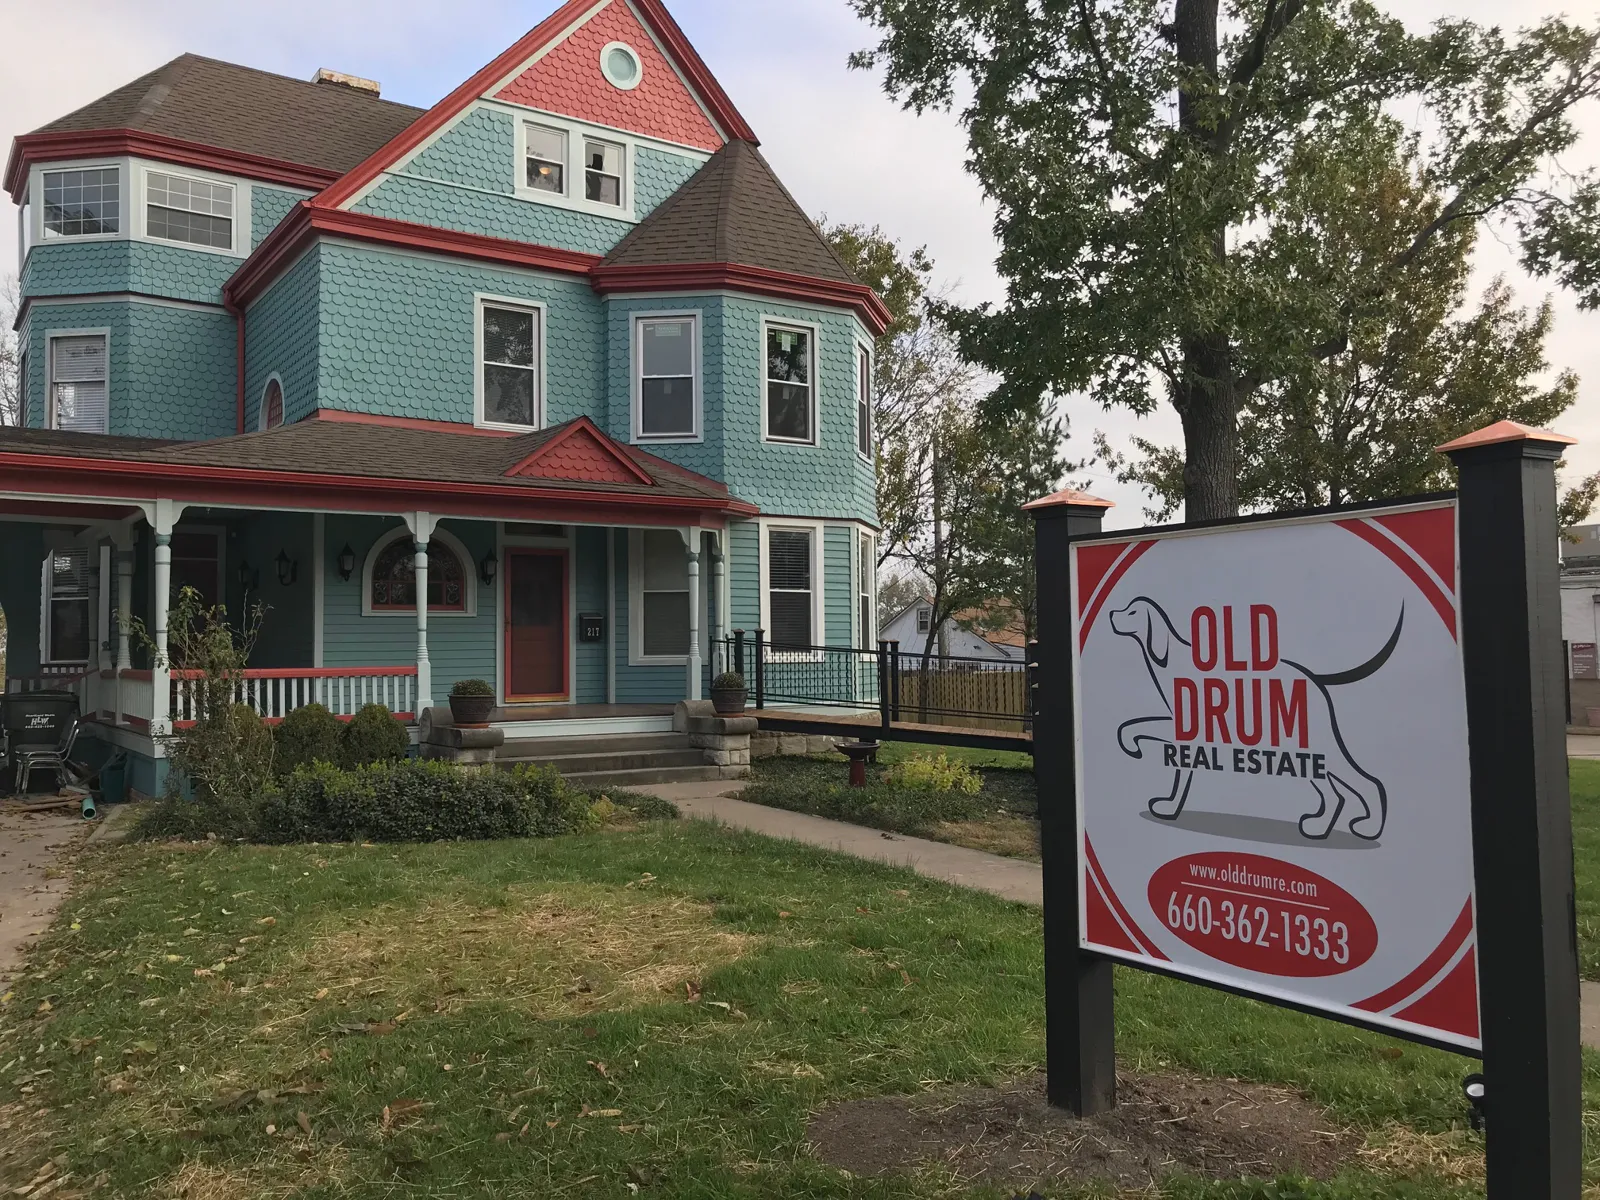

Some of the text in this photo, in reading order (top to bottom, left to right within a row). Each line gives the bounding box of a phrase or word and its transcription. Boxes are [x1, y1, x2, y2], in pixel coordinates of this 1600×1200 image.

[587, 627, 600, 637] 217
[1191, 604, 1279, 672] OLD
[1173, 677, 1309, 749] DRUM
[1163, 743, 1326, 780] REAL ESTATE
[1189, 863, 1318, 898] www.olddrumre.com
[1167, 891, 1350, 965] 660-362-1333
